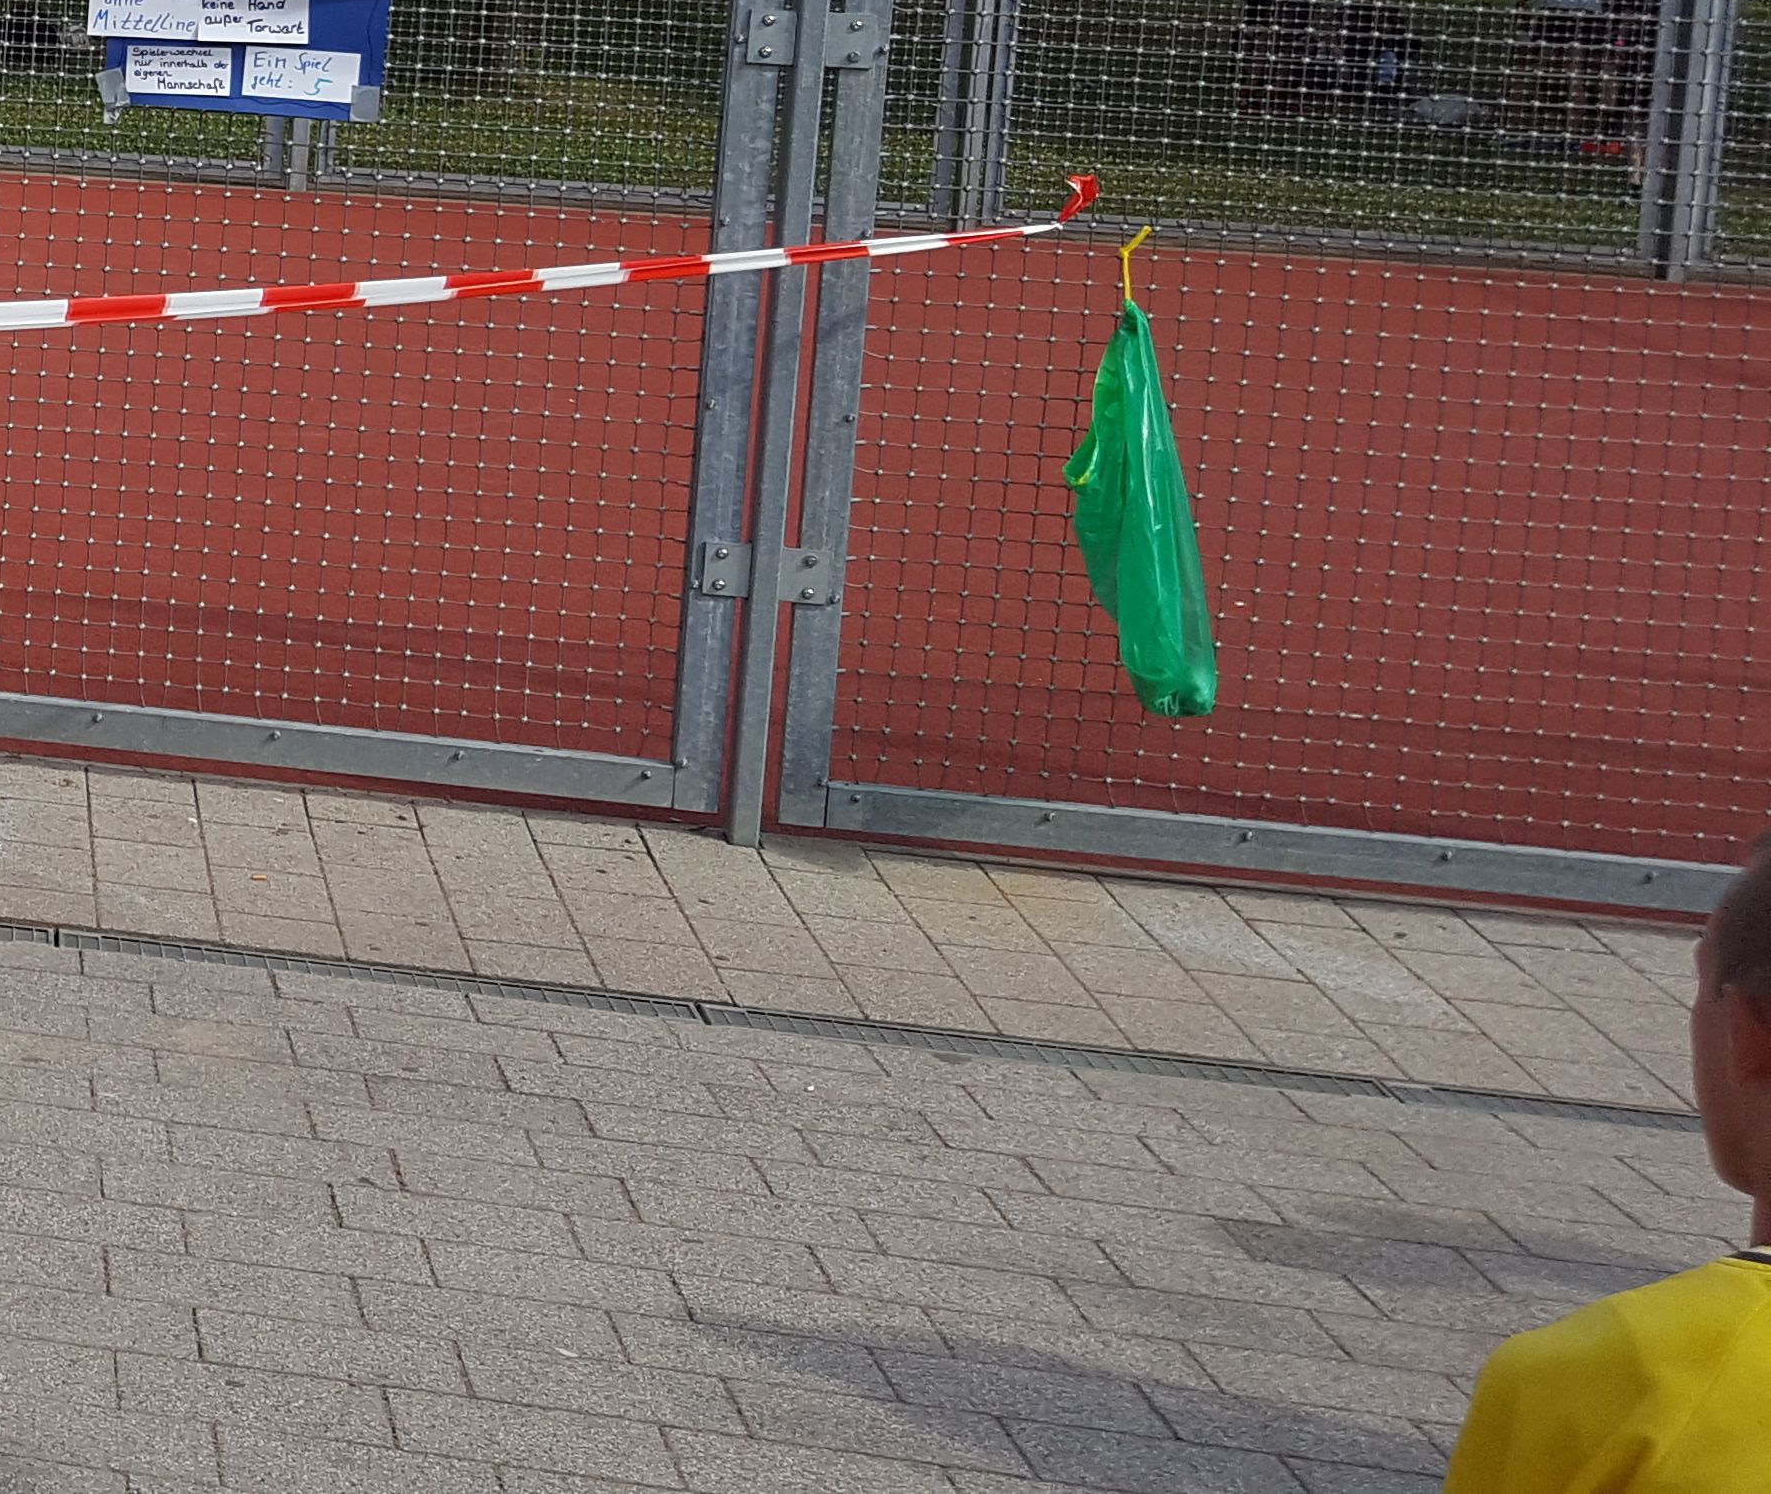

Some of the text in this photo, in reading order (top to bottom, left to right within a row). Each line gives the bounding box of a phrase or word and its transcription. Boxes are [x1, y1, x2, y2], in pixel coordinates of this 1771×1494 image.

[204, 13, 305, 36] außer Torwart
[253, 52, 332, 76] Ein Spiel
[157, 77, 226, 96] Mannschaft
[303, 78, 333, 96] 5
